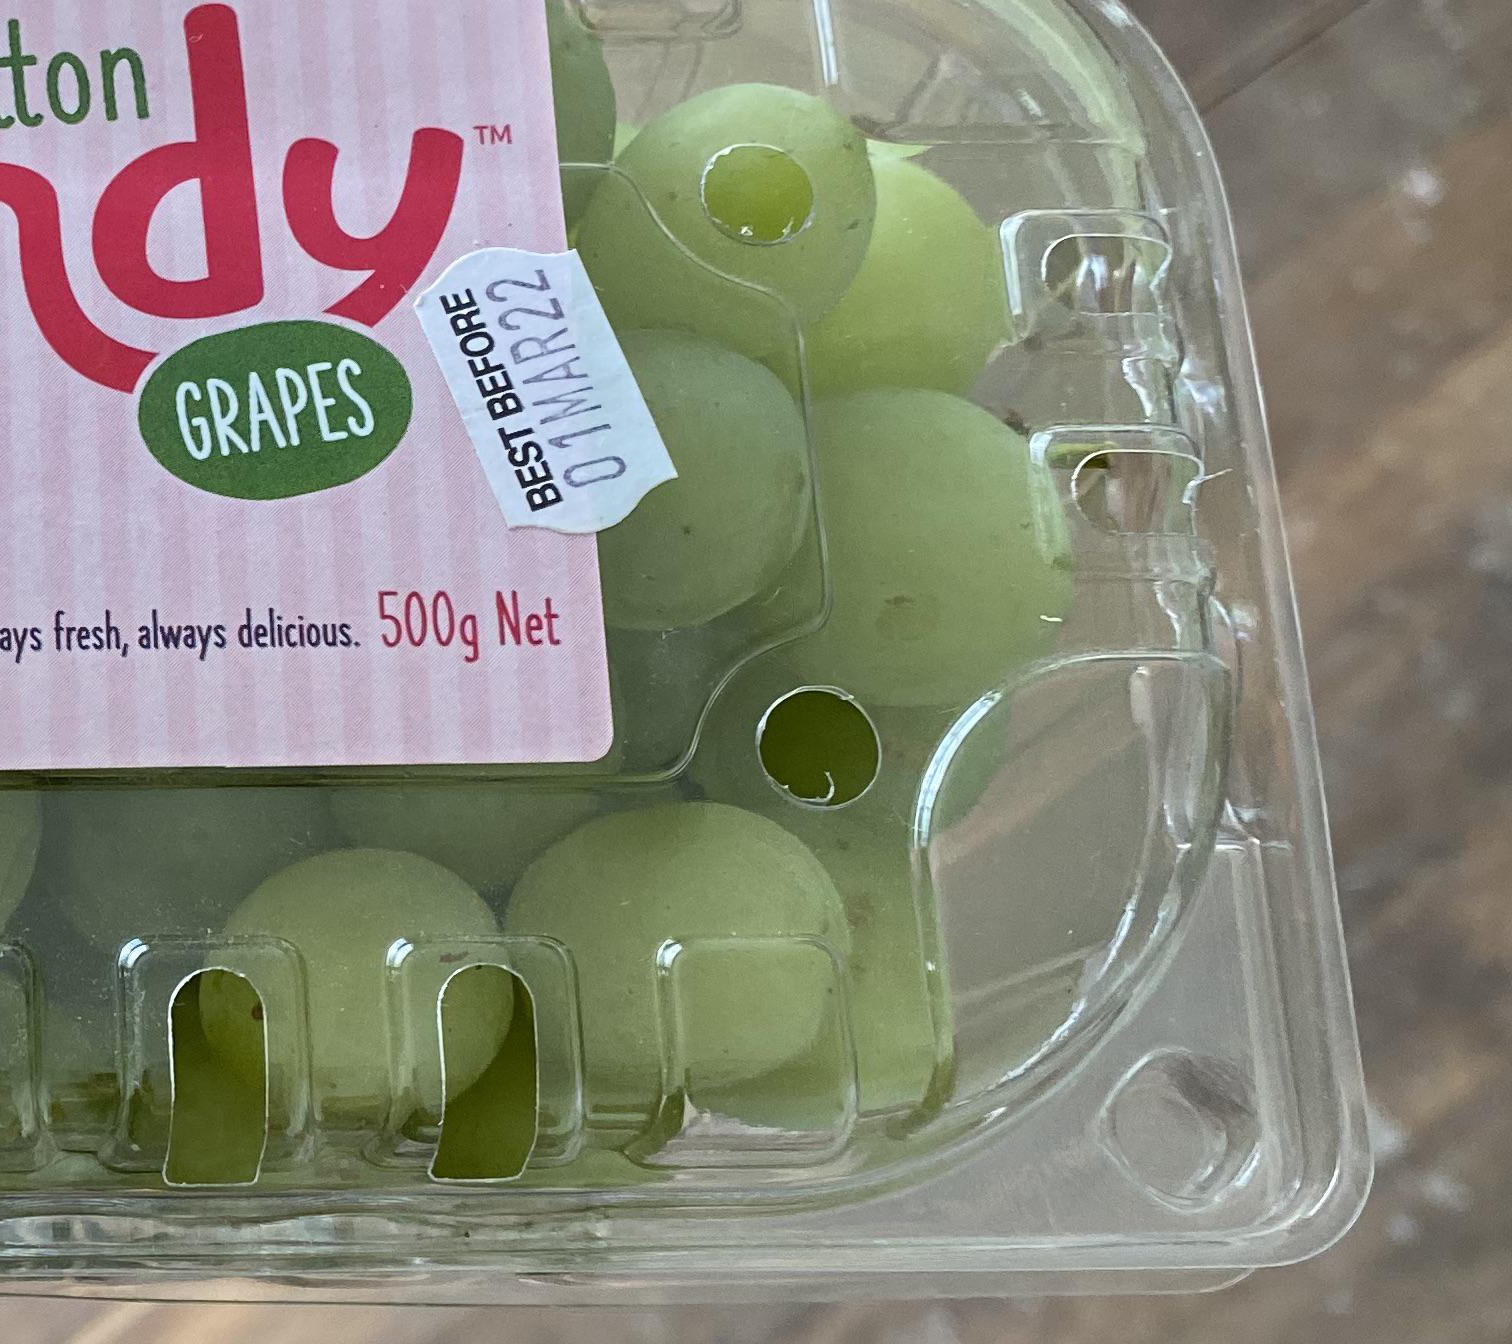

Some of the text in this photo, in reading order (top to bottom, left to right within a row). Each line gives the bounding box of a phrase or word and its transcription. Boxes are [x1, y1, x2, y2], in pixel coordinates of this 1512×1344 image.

[174, 358, 376, 462] GRAPES
[439, 287, 564, 513] BEST BEFORE
[53, 608, 129, 658] fresh,
[137, 608, 227, 661] always
[237, 607, 362, 650] delicious.
[377, 589, 562, 663] 500g Net
